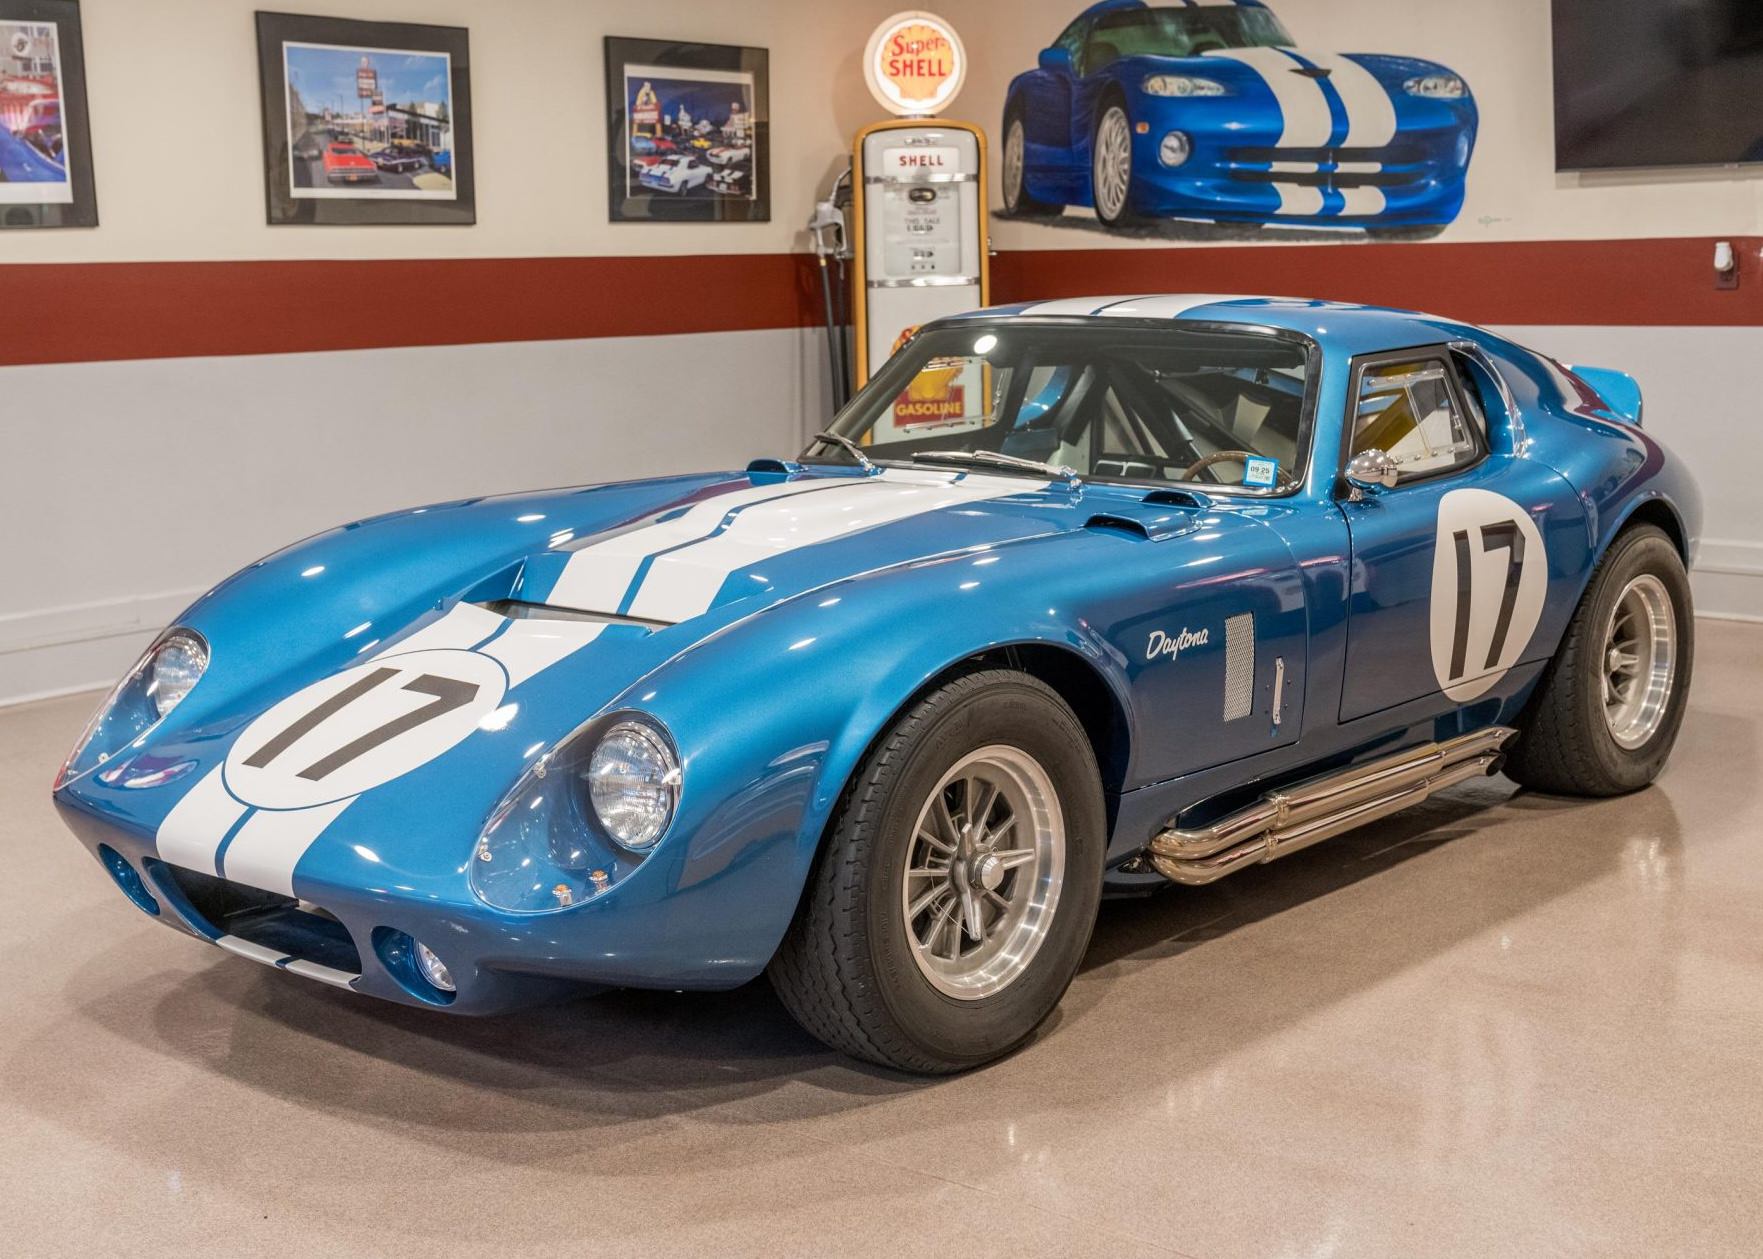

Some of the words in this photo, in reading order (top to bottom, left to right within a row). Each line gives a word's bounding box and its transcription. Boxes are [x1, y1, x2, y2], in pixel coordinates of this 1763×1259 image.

[889, 59, 946, 77] SHELL
[899, 155, 944, 167] SHELL
[896, 402, 962, 416] GASOLINE
[1448, 518, 1527, 681] 17
[1145, 627, 1209, 661] Daytona
[241, 666, 480, 782] 17
